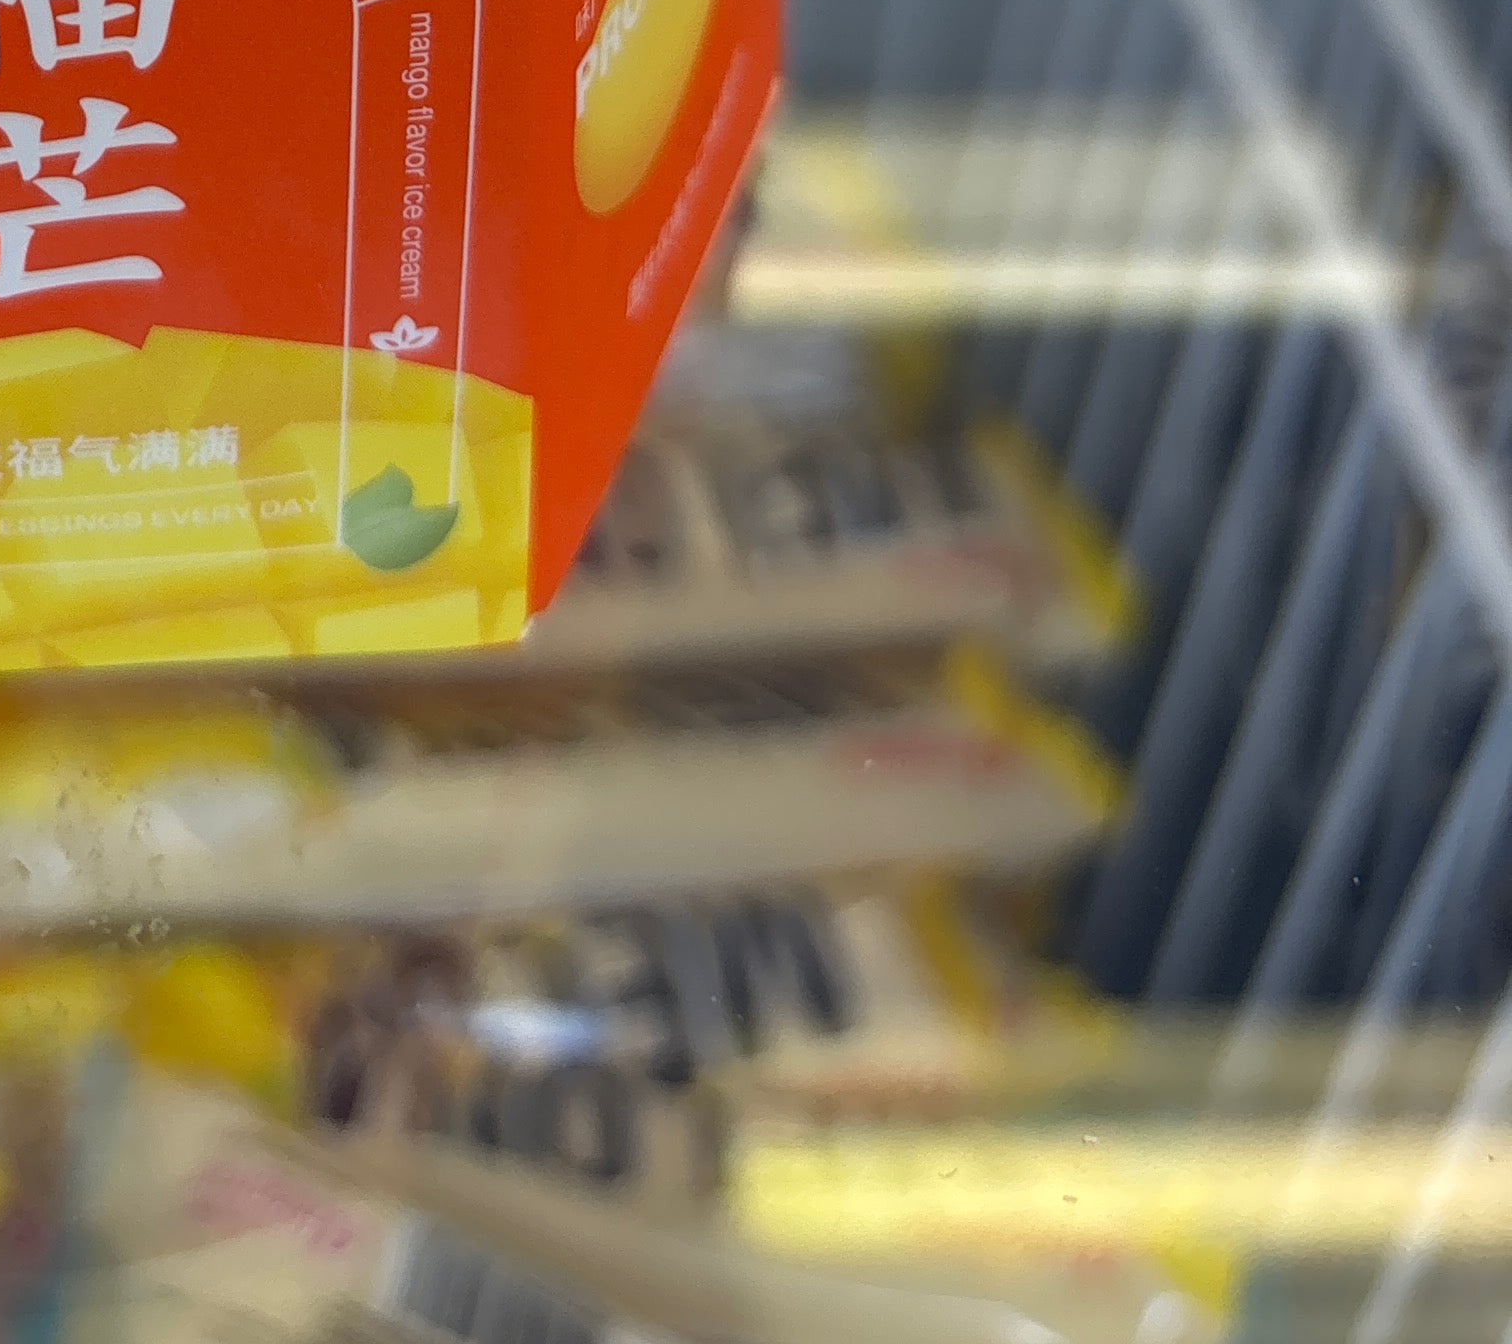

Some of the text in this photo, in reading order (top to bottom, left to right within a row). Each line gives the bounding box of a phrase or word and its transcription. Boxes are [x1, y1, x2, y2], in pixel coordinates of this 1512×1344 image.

[400, 12, 434, 299] mango flavor ice cream
[150, 500, 252, 529] EVERY
[259, 496, 320, 522] DAY
